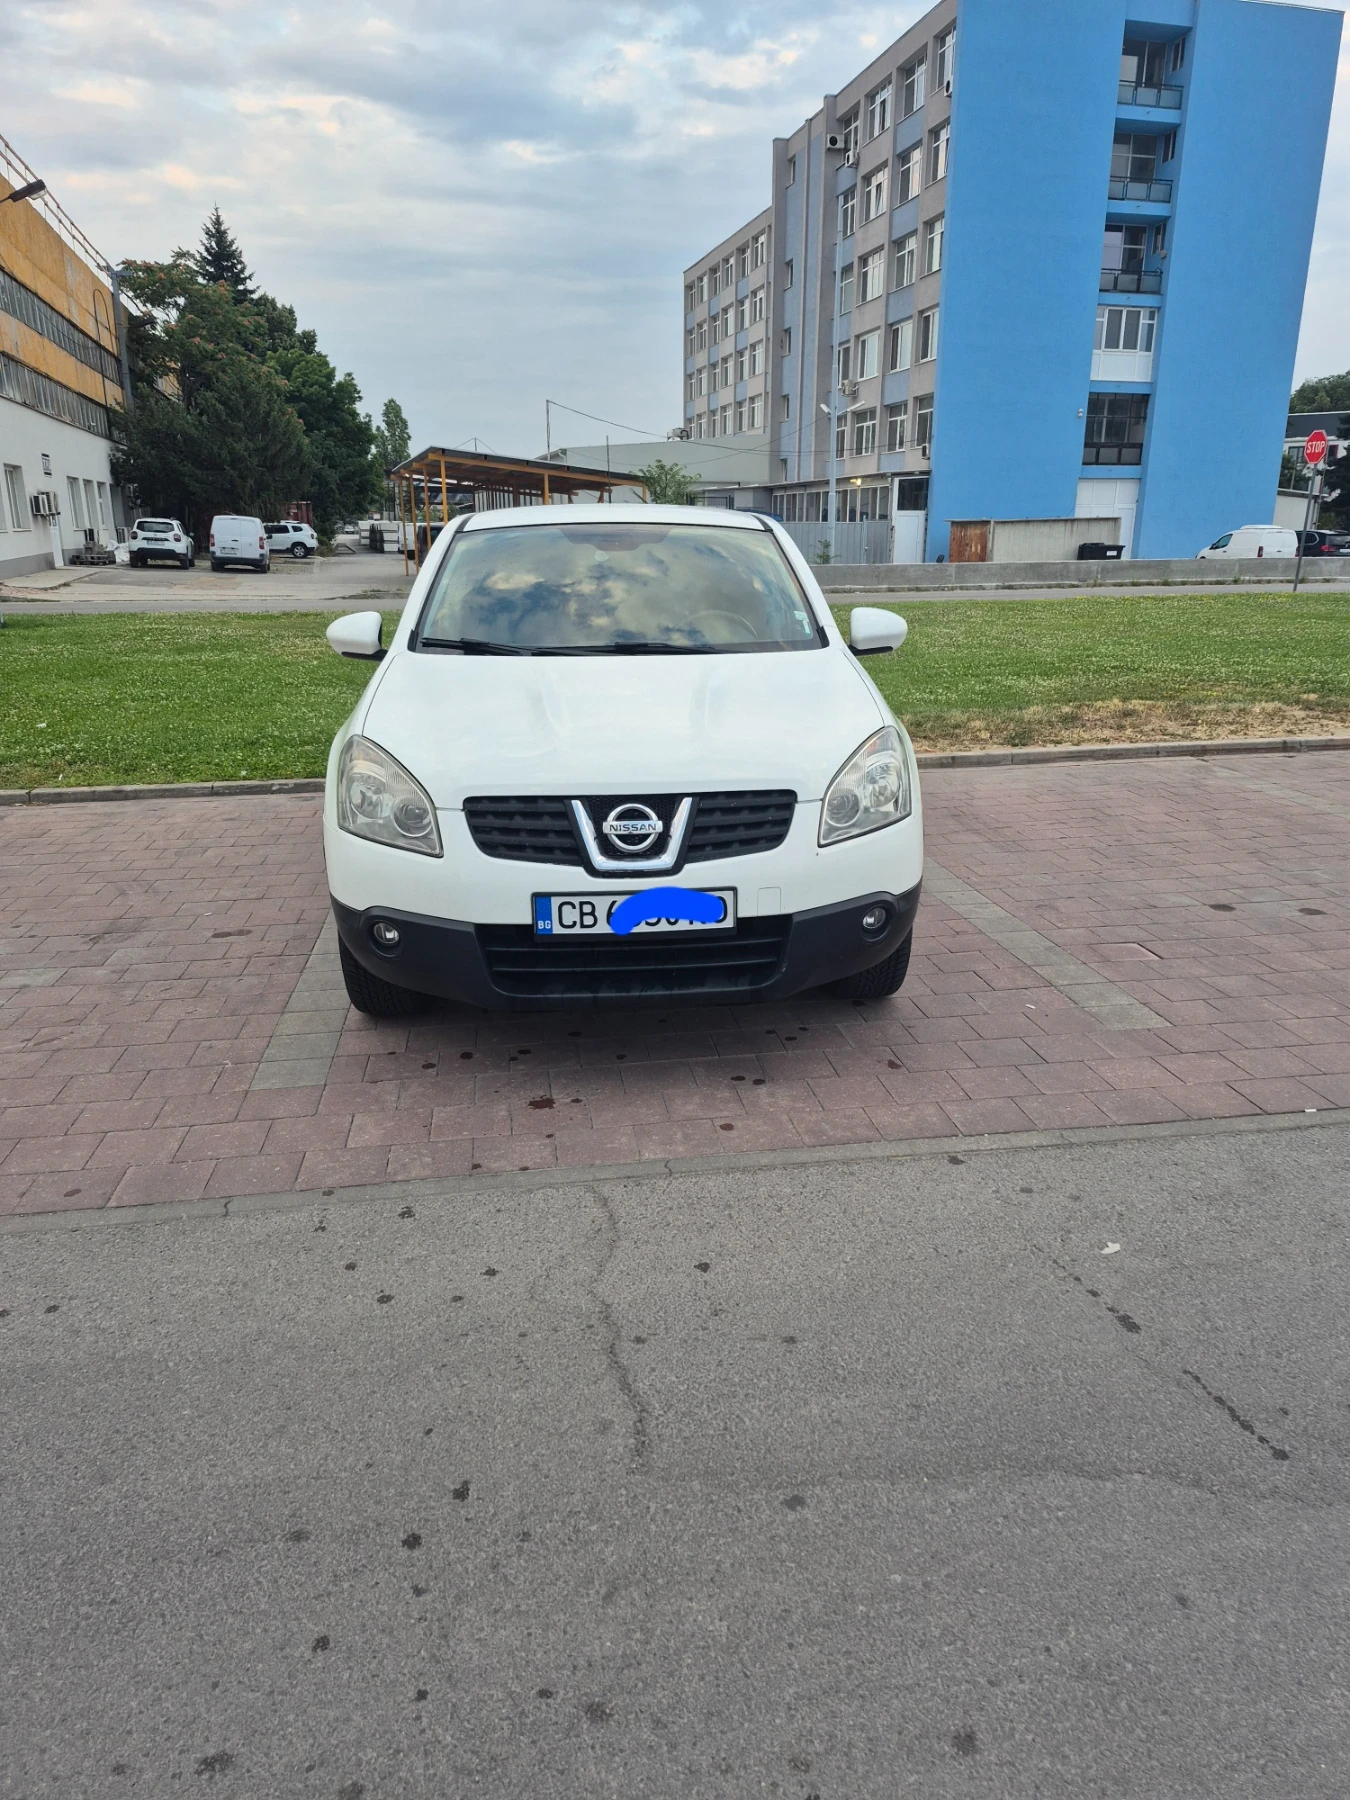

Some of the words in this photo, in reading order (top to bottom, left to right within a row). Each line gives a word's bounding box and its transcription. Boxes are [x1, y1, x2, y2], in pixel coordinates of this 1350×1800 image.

[1307, 441, 1325, 453] STOP
[609, 823, 656, 832] NISSAN
[538, 921, 551, 929] BG
